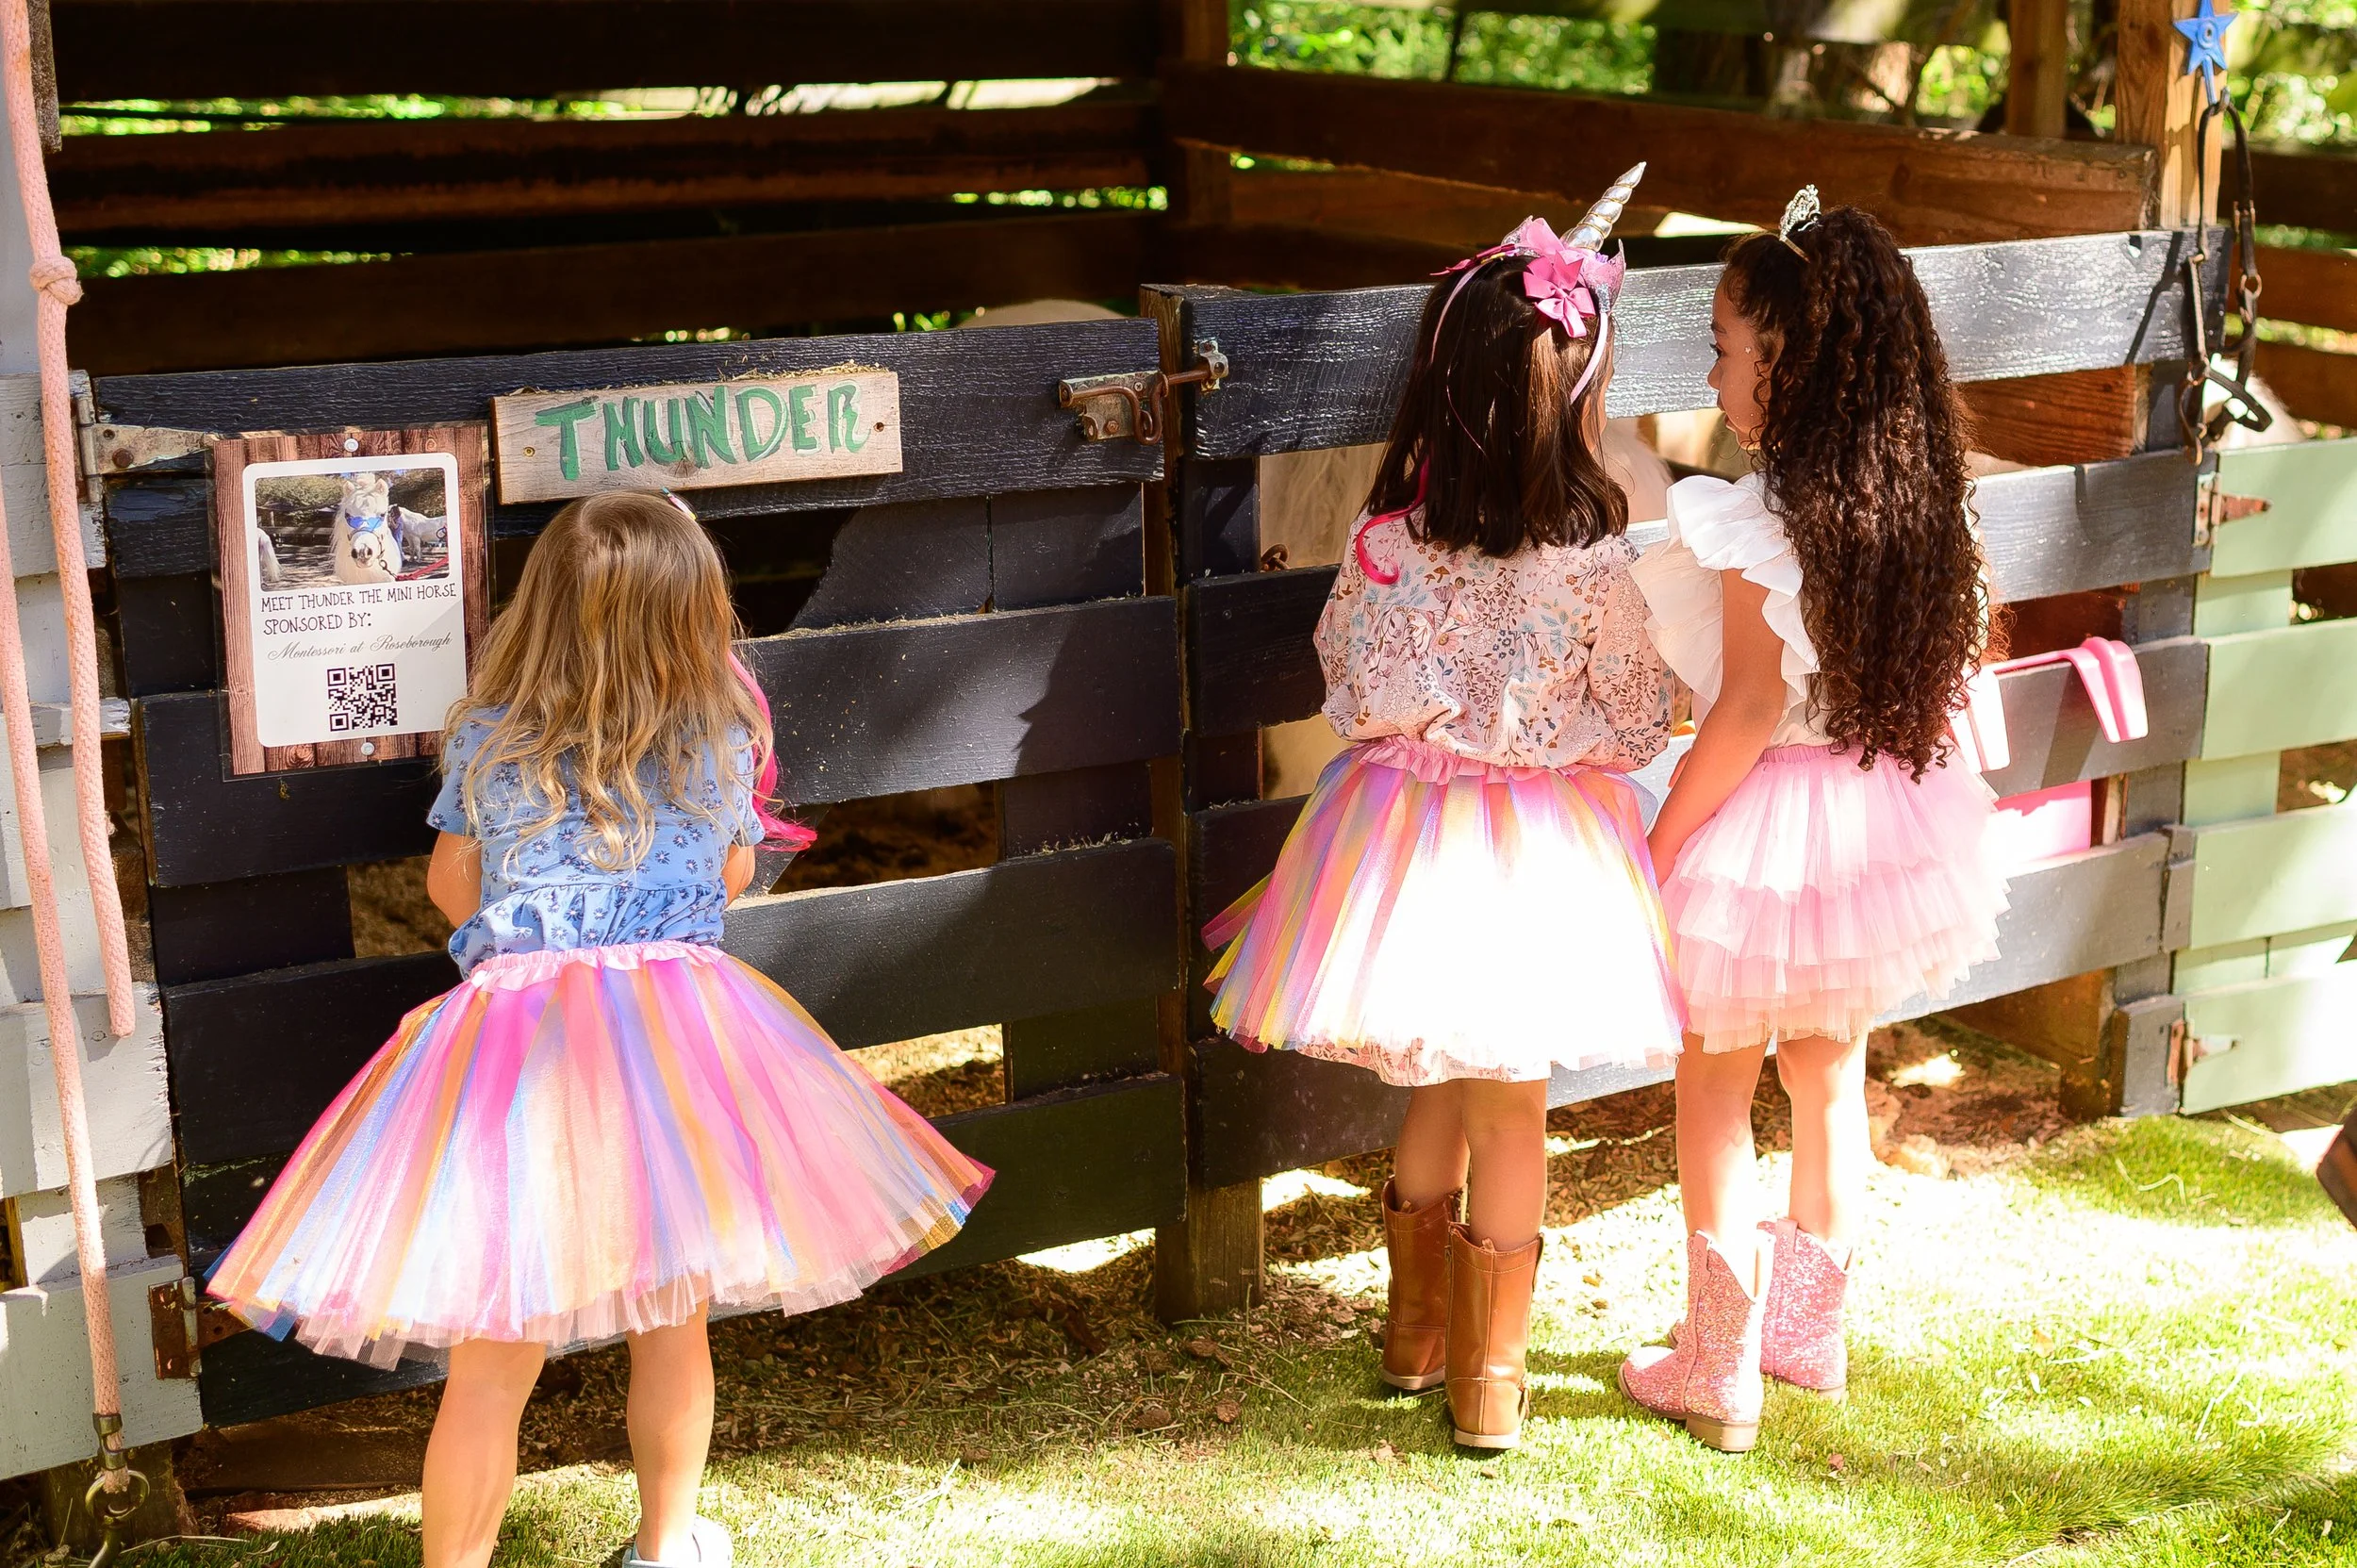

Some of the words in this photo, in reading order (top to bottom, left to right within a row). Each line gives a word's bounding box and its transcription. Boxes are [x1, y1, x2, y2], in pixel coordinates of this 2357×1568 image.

[535, 380, 870, 480] THUNDER
[261, 596, 293, 613] MEET
[298, 590, 354, 609] THUNDER
[359, 589, 383, 604] THE
[387, 586, 412, 602] MINI
[417, 583, 456, 600] HORSE
[263, 614, 343, 635] SPONSORED
[349, 612, 371, 628] BY:
[268, 641, 346, 660] Montessori
[350, 642, 364, 653] at
[370, 633, 453, 653] Roseborough
